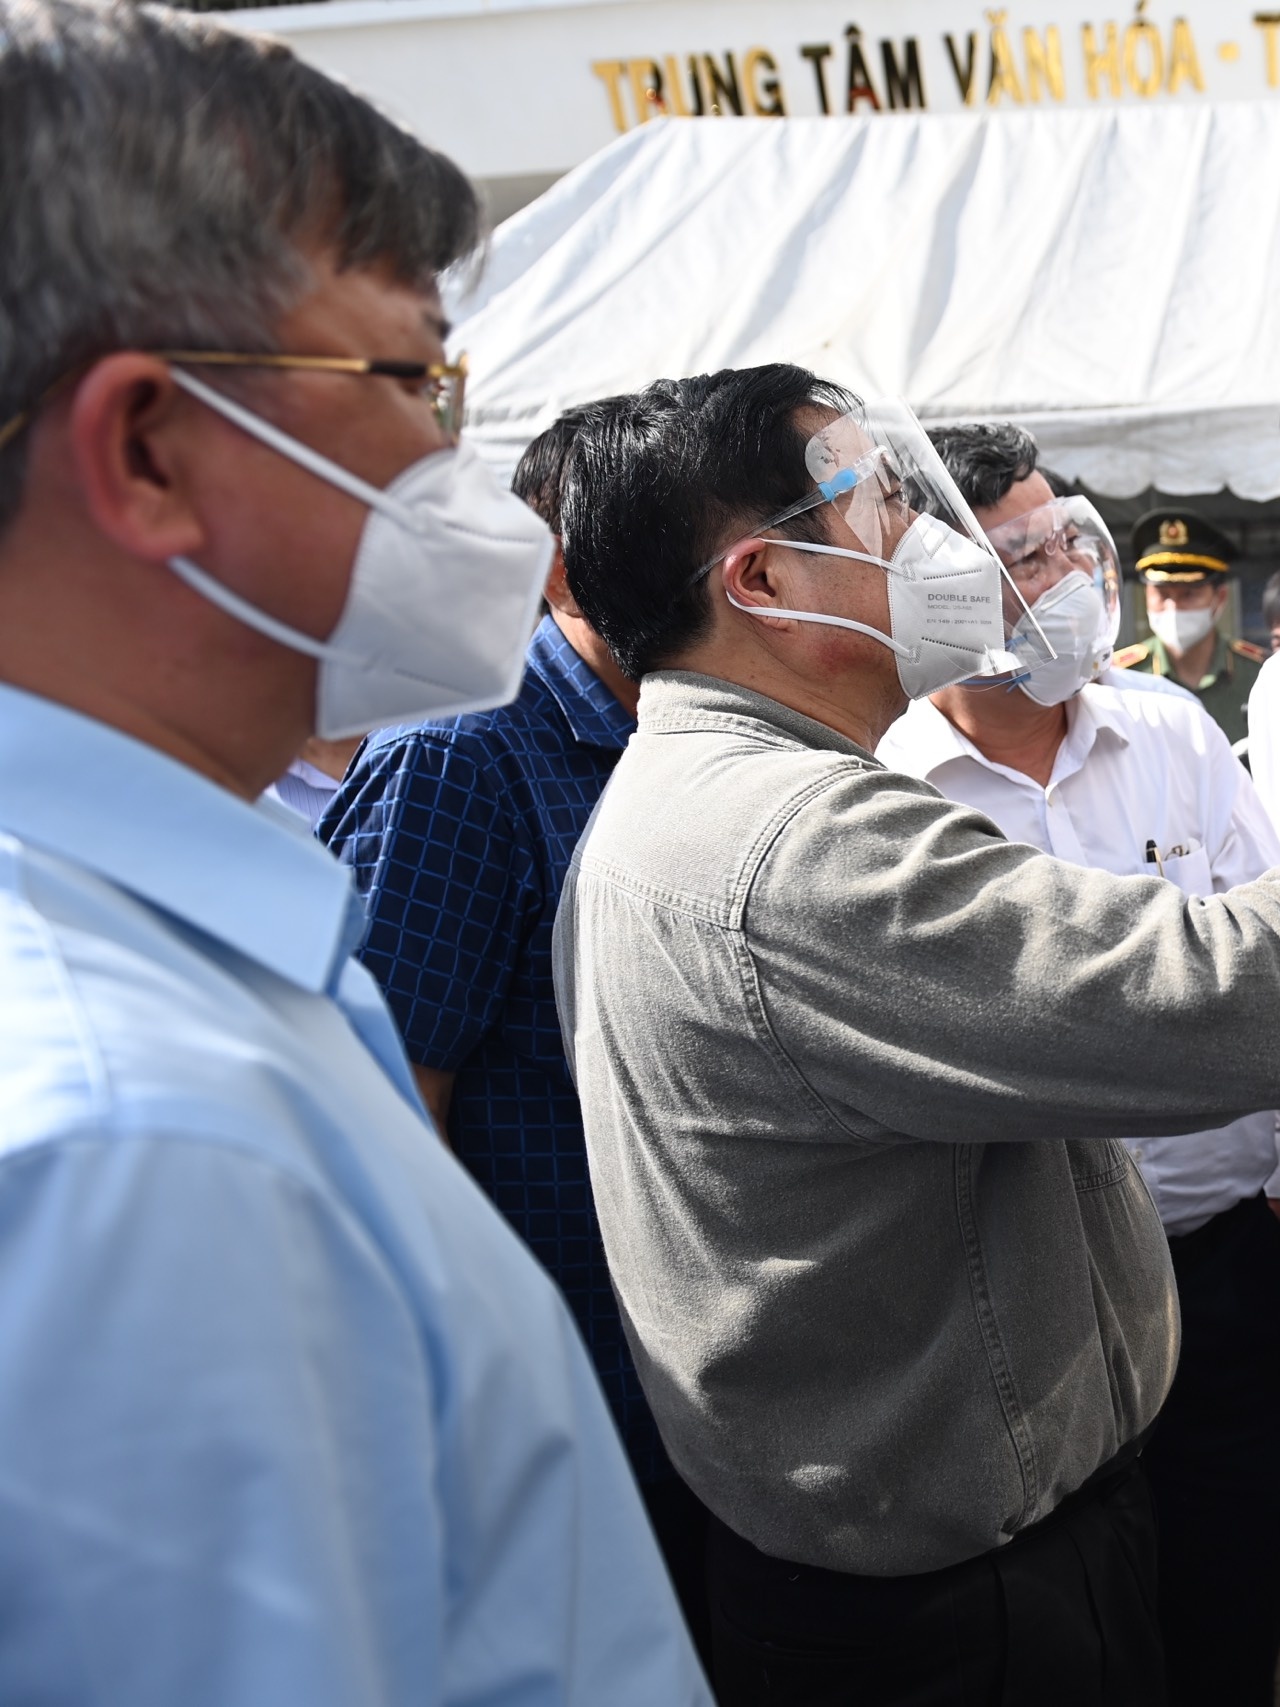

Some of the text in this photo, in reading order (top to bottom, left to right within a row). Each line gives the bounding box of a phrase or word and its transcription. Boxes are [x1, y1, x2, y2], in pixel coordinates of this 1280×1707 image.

[590, 45, 786, 133] TRUNG
[798, 22, 926, 115] TÂM
[943, 8, 1065, 107] VĂN
[1080, 0, 1205, 101] HÓA
[927, 593, 991, 603] DOUBLE SAFE
